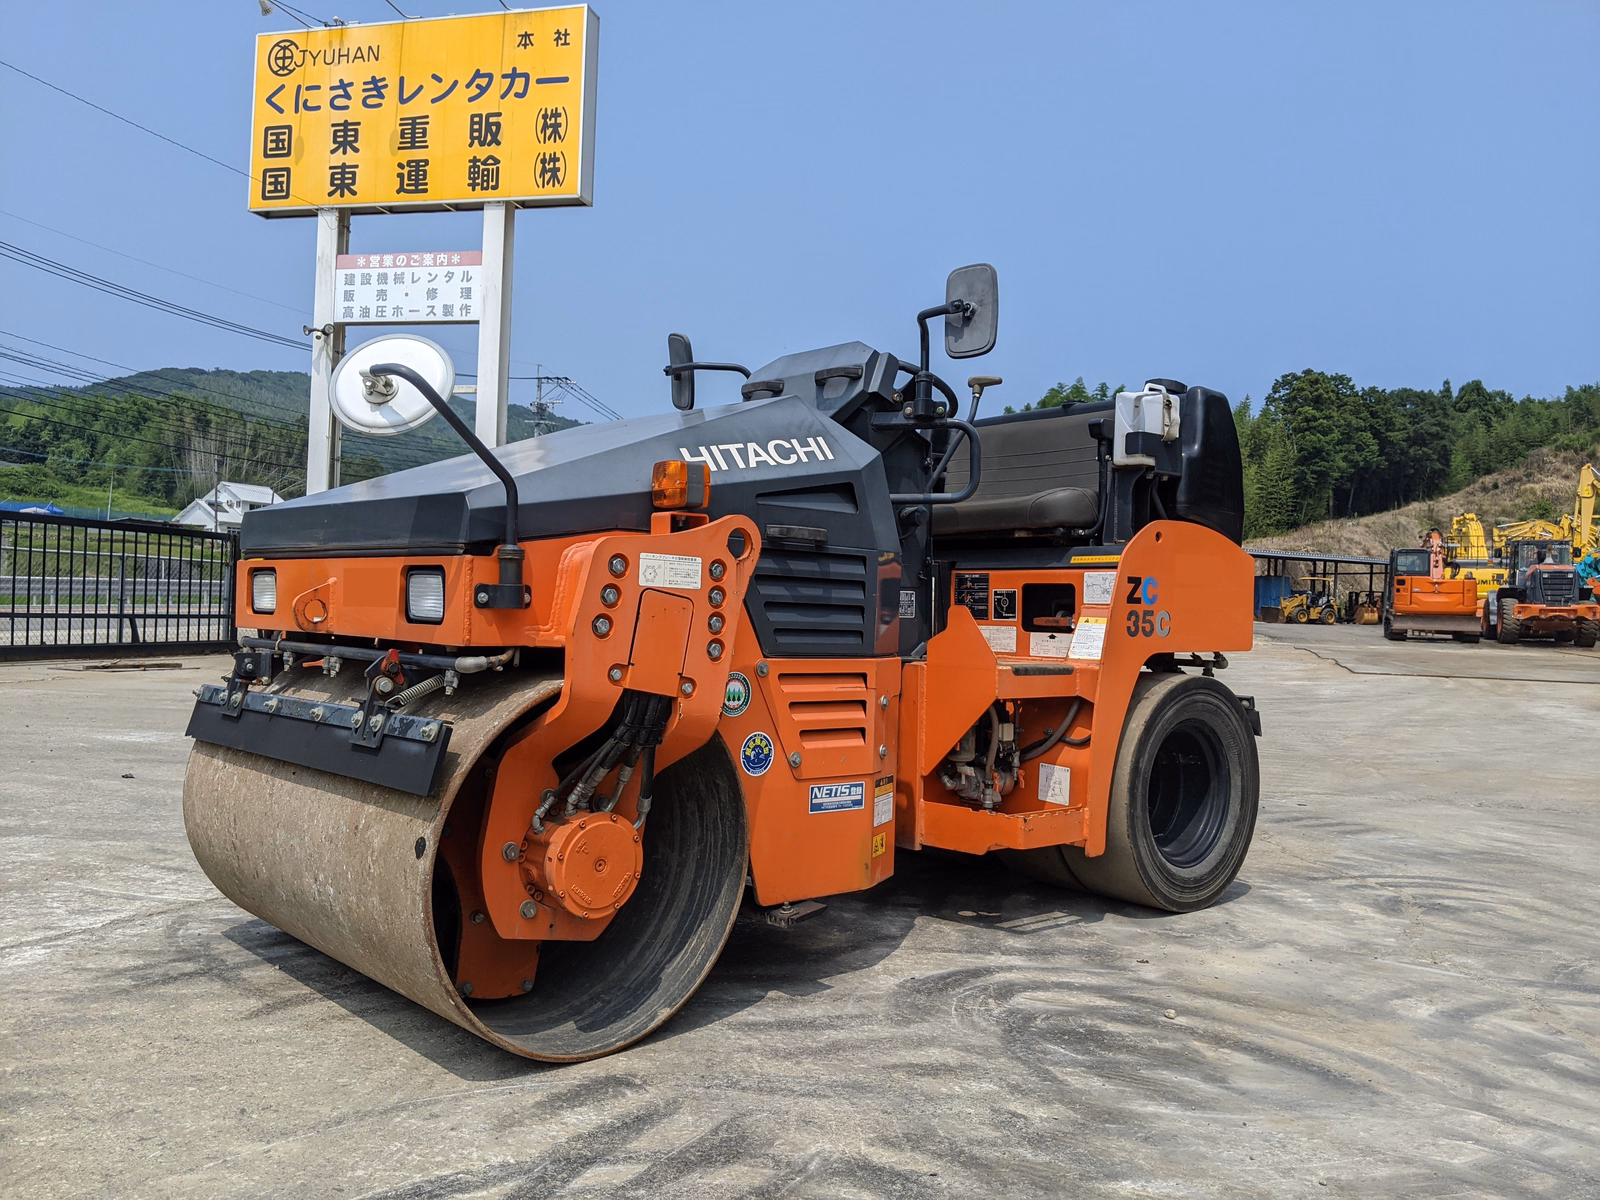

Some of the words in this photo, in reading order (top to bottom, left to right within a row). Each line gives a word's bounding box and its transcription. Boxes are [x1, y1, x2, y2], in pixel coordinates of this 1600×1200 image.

[518, 29, 571, 49] 本社
[294, 45, 380, 67] JYUHAN
[266, 67, 570, 114] くにさきレンタカー
[344, 270, 473, 286] 建設機械レンタル
[342, 304, 472, 319] 高油圧ホース製作
[679, 436, 835, 472] HITACHI
[1126, 576, 1159, 606] ZC
[1126, 609, 1172, 638] 35C
[811, 785, 851, 799] NETIS
